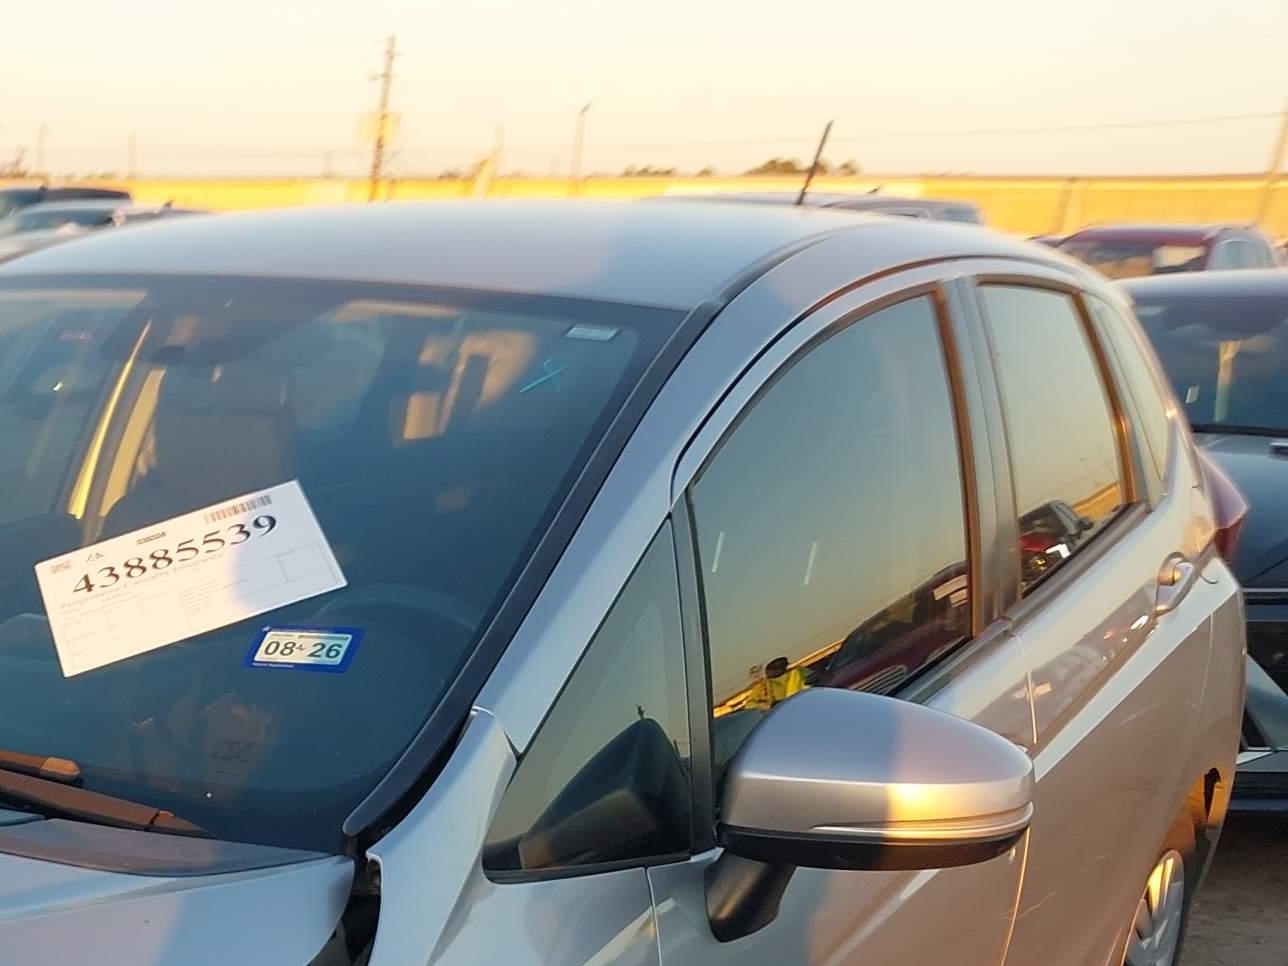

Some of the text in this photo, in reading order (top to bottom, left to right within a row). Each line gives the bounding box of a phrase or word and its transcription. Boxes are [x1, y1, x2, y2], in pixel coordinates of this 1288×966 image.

[72, 514, 277, 593] 43885539
[264, 640, 343, 659] 08 26
